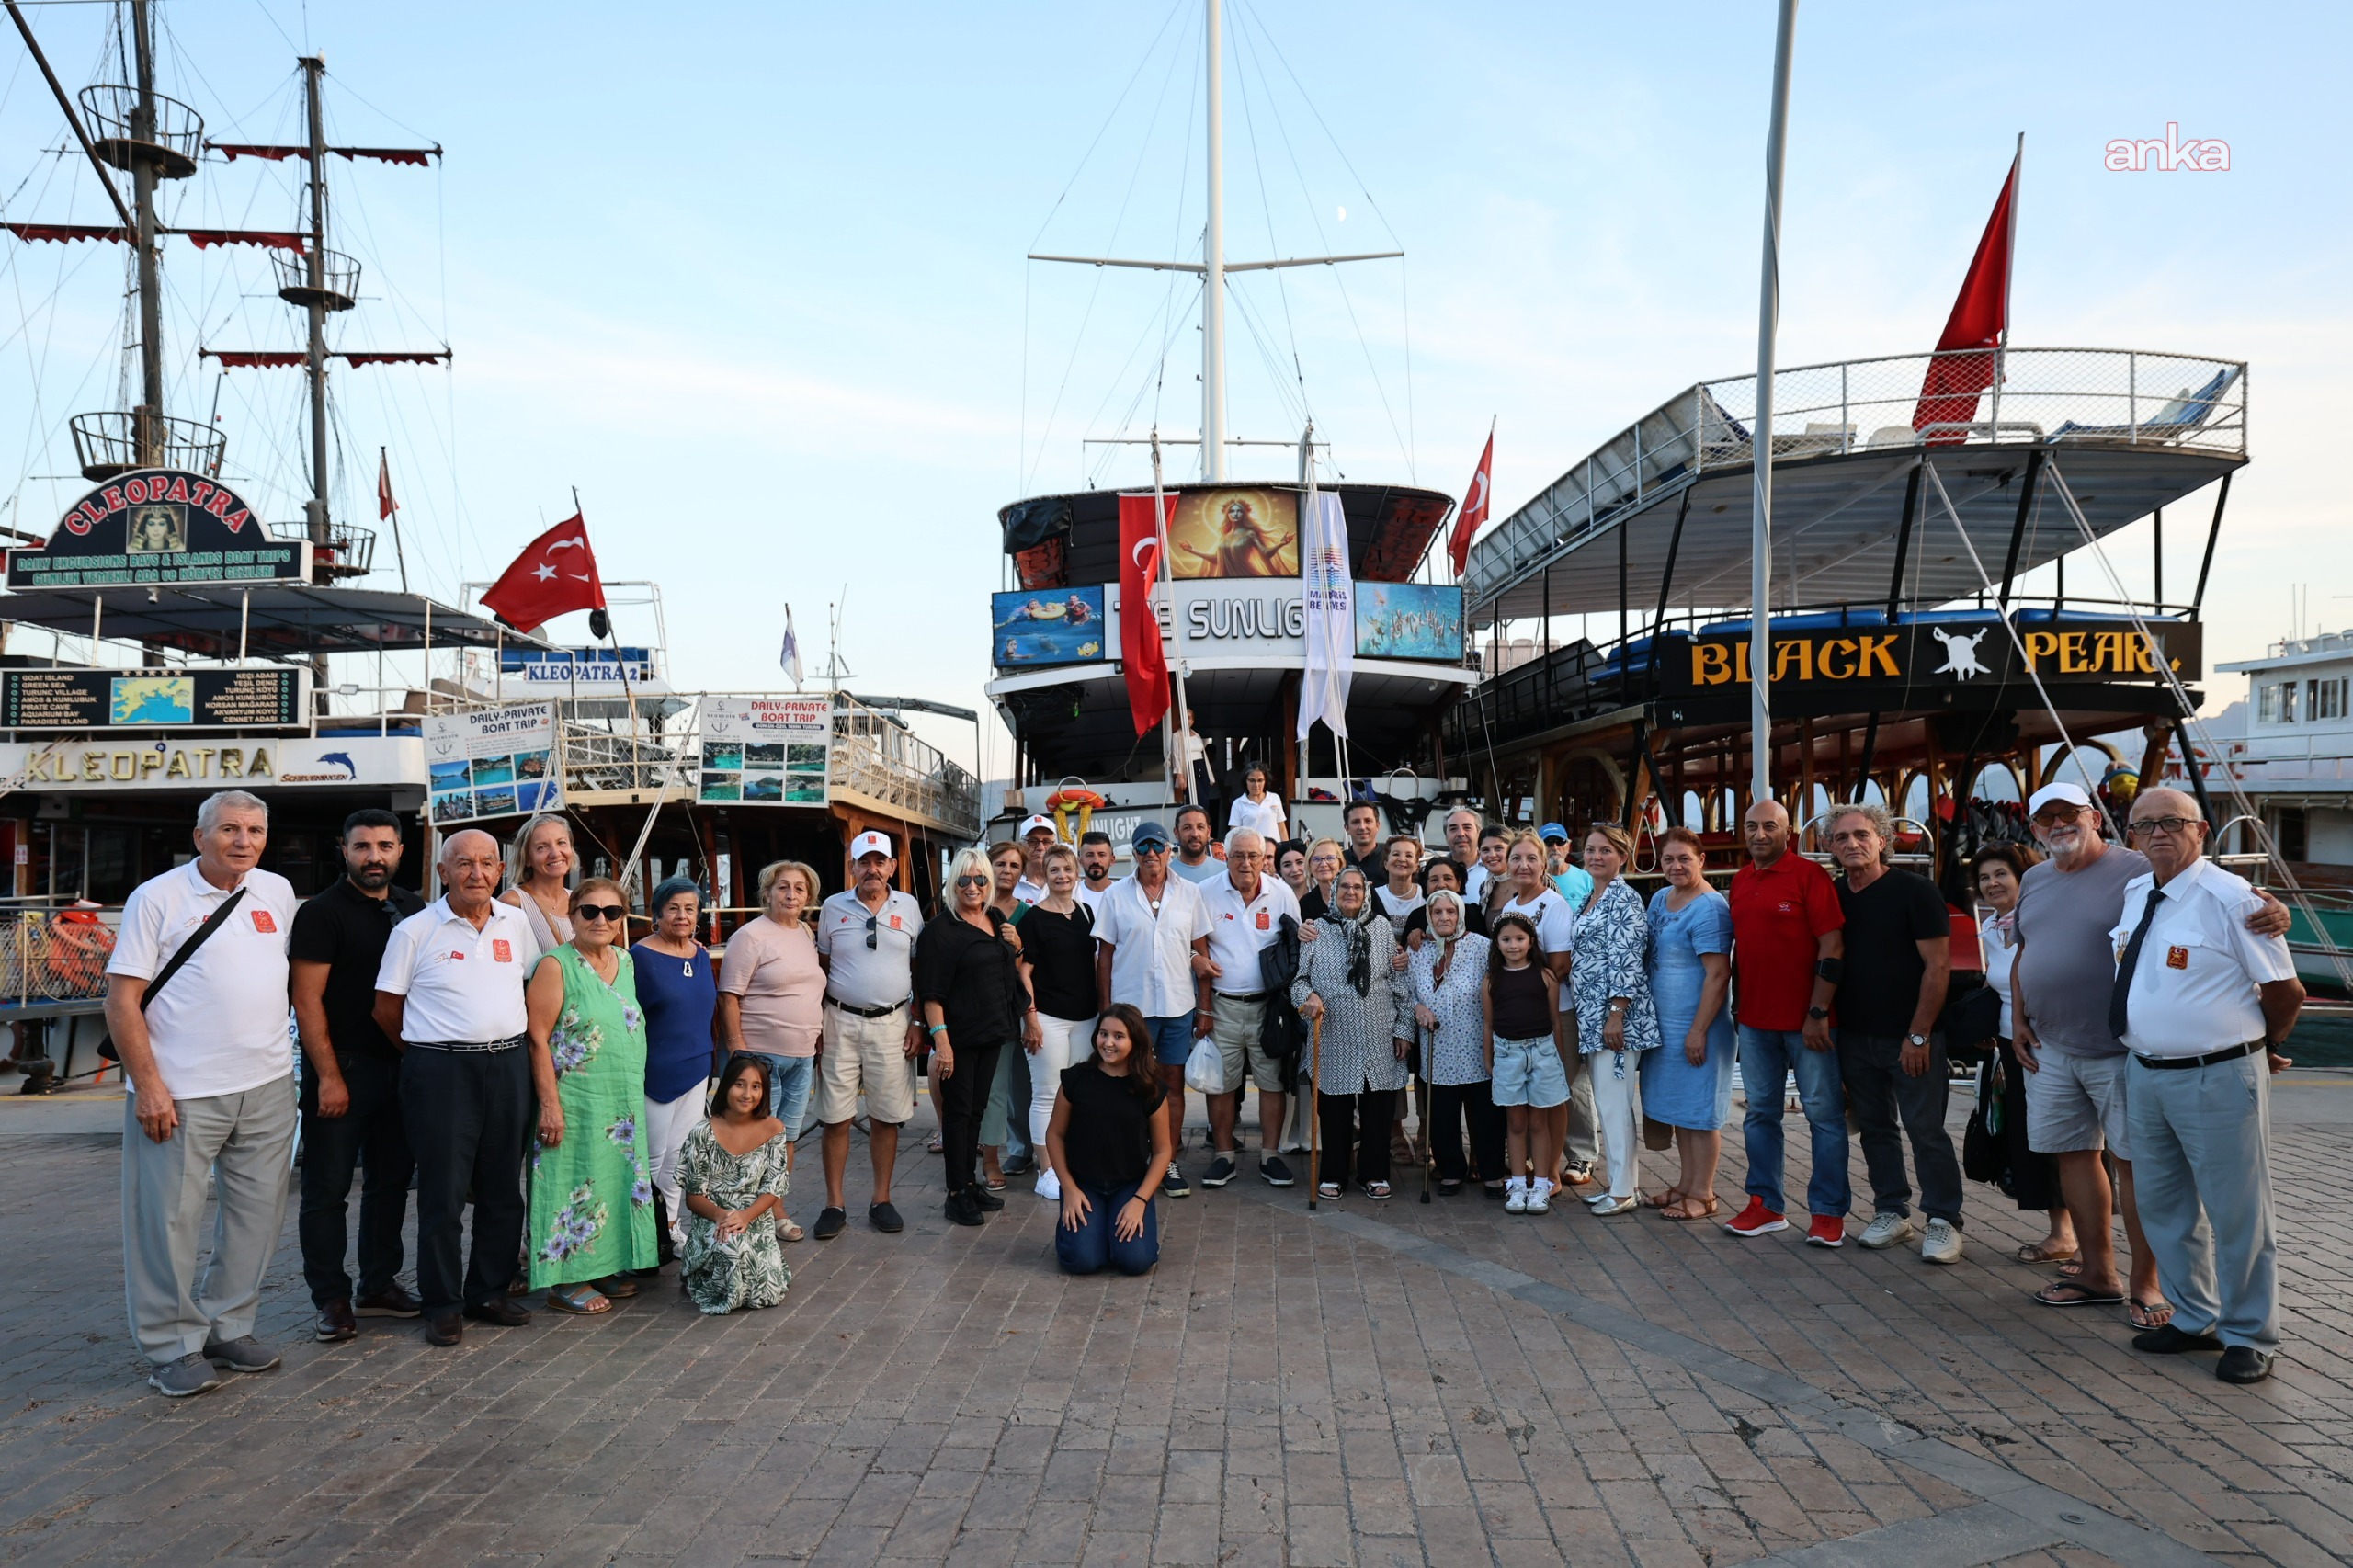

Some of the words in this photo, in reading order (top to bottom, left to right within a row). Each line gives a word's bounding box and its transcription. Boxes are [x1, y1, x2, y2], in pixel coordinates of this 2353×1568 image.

[65, 476, 249, 536] CLEOPATRA
[17, 558, 51, 571] DAILY
[52, 555, 127, 570] EXCURSIONS
[130, 554, 159, 568] BAYS
[161, 553, 171, 566] &
[173, 552, 222, 566] ISLANDS
[224, 551, 255, 564] BOAT
[256, 550, 290, 562] TRIPS
[135, 569, 160, 582] ADA
[179, 565, 223, 580] KÖRFEZ
[1188, 598, 1305, 639] SUNLIG
[1691, 634, 1901, 686] BLACK
[529, 665, 624, 681] KLEOPATRA
[629, 667, 638, 681] 2
[470, 705, 548, 724] DAILY-PRIVATE
[751, 701, 827, 712] DAILY-PRIVATE
[482, 722, 511, 734] BOAT
[514, 719, 538, 732] TRIP
[761, 712, 790, 722] BOAT
[793, 713, 816, 722] TRIP
[24, 747, 273, 782] KLEOPATRA
[1091, 816, 1142, 841] UNLIGHT
